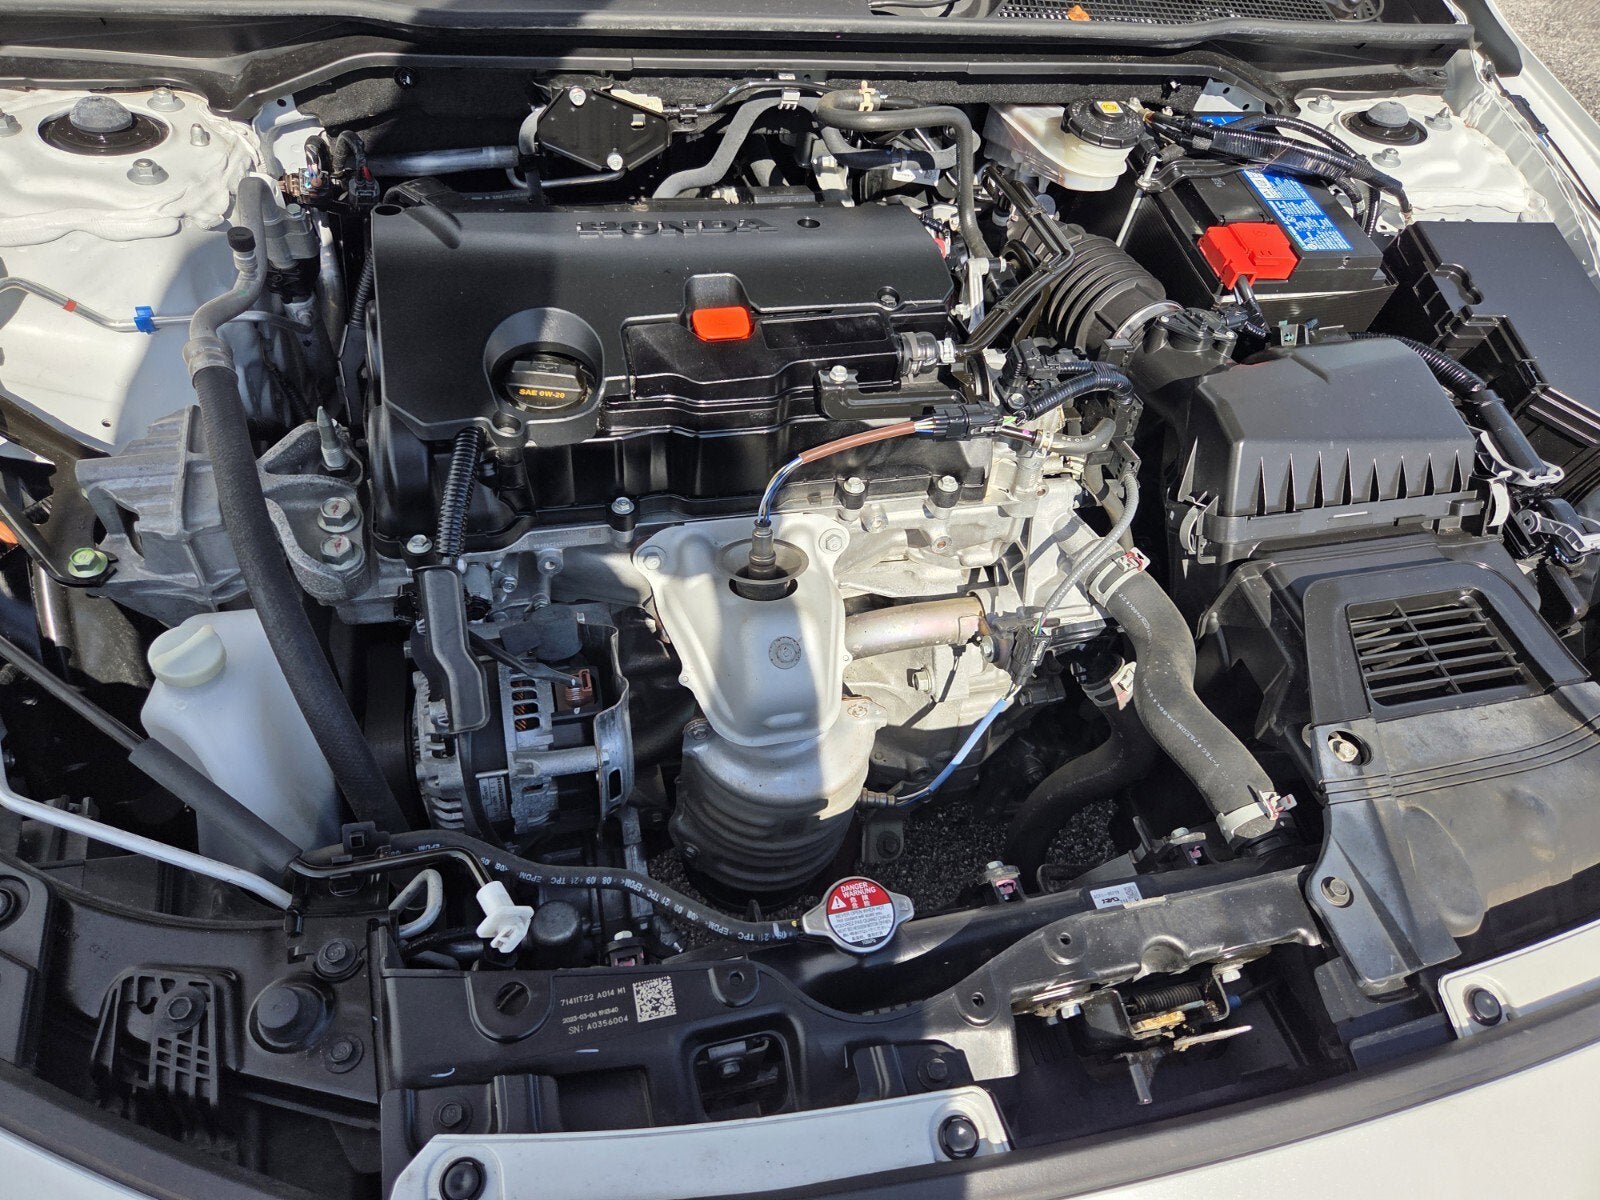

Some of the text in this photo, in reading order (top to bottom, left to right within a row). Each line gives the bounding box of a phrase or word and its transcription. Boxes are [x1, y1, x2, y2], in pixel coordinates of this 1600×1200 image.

[576, 219, 778, 238] HONDA
[519, 388, 565, 399] SAE 0W-20
[550, 877, 566, 885] TPC
[841, 882, 867, 892] DANGER
[737, 931, 755, 941] TPC
[560, 993, 594, 1006] 71411T22
[597, 989, 615, 999] A014
[562, 1011, 598, 1024] 2023-03-06
[568, 1014, 629, 1035] SN: A0356004
